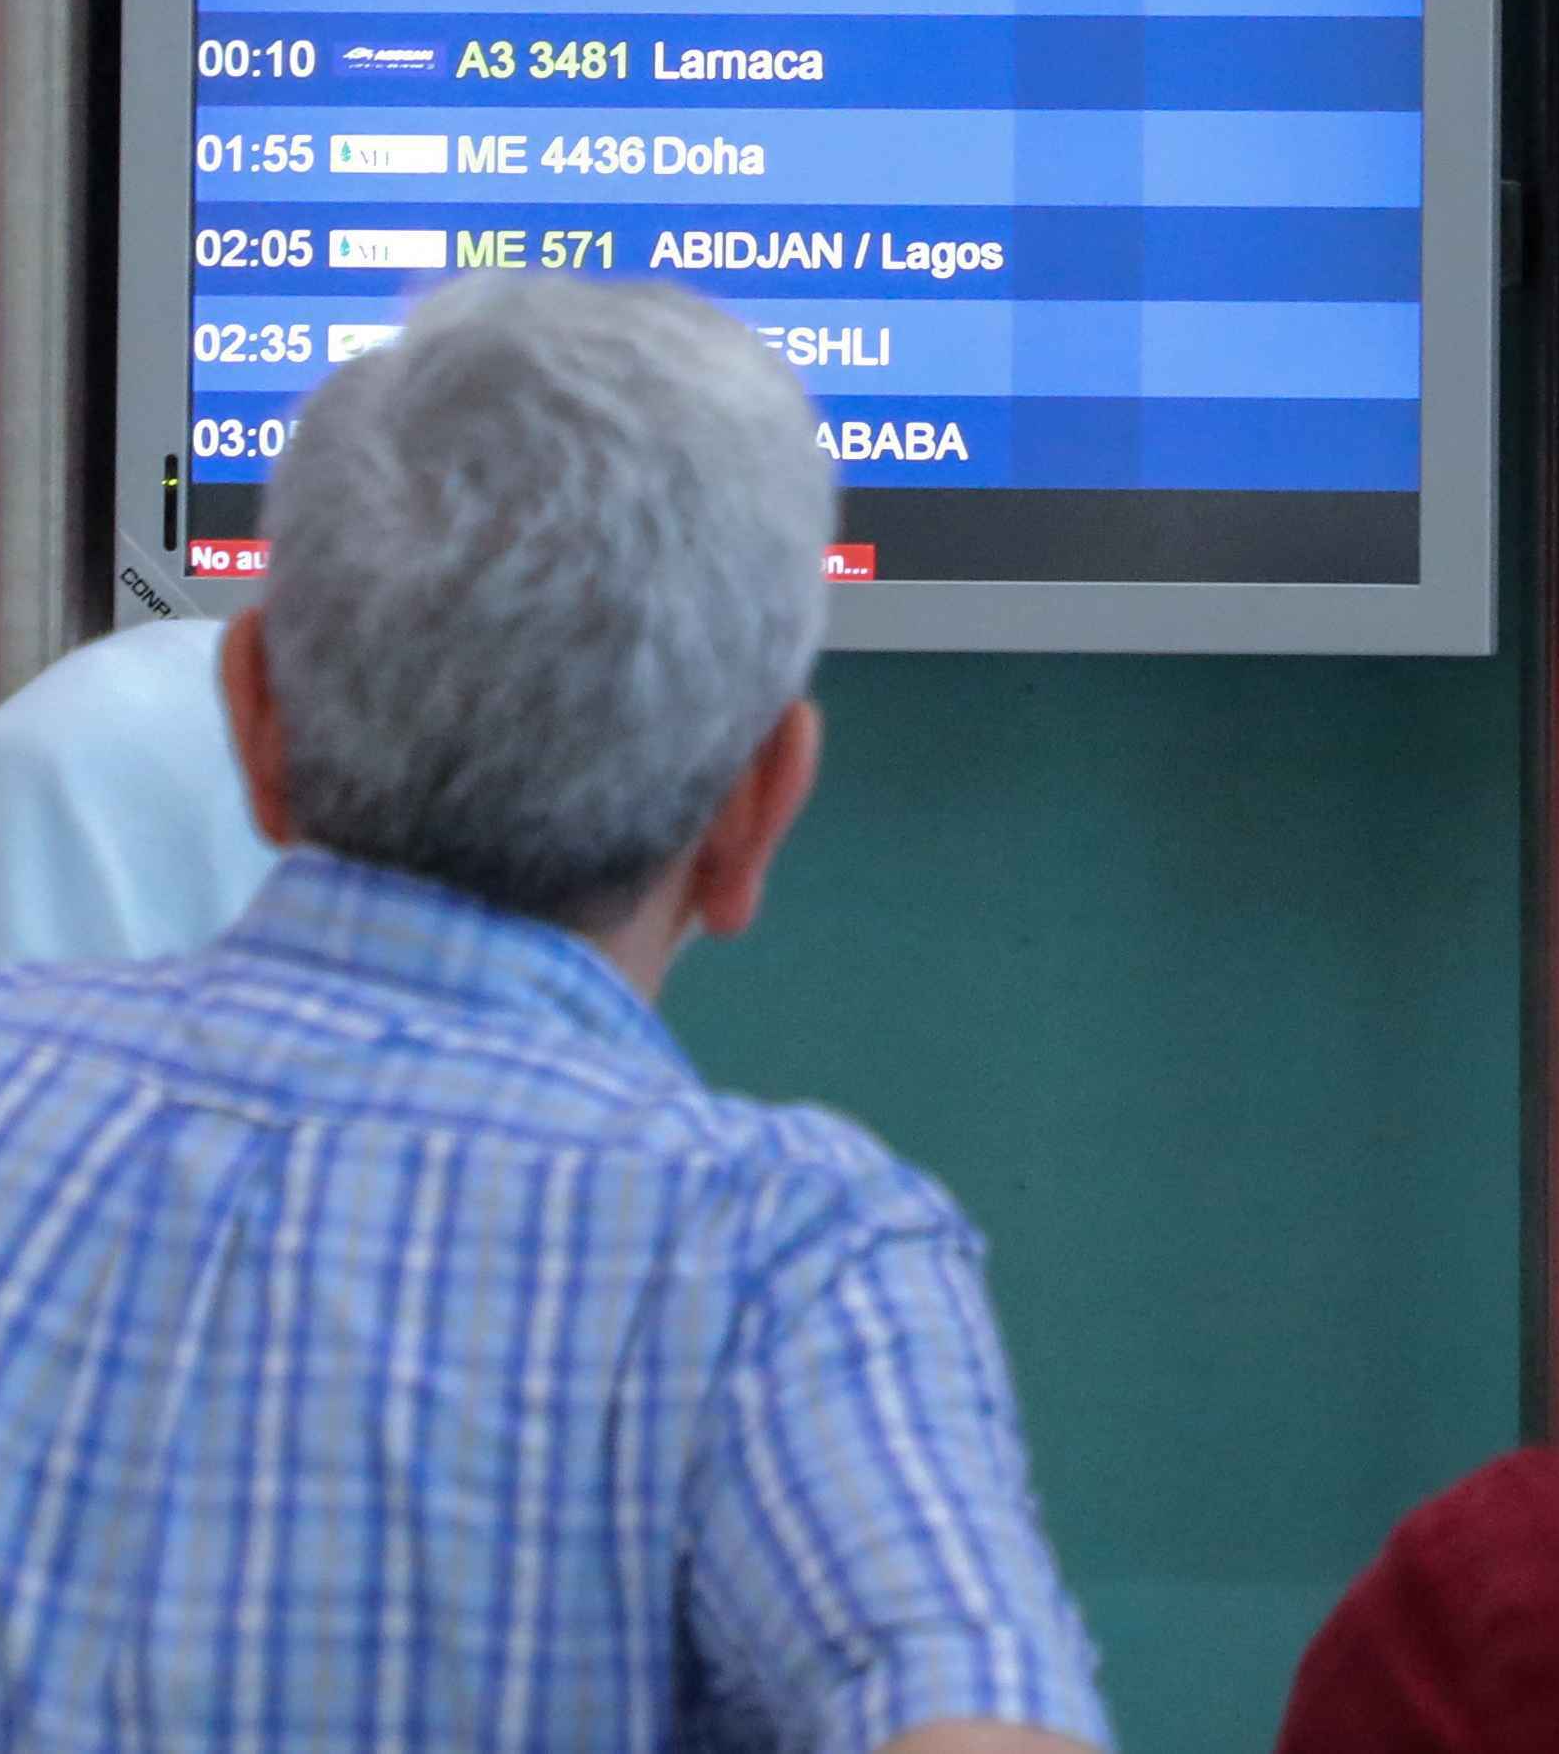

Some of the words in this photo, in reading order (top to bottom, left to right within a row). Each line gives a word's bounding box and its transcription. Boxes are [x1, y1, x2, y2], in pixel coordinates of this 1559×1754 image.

[198, 39, 316, 78] 00:10
[455, 40, 516, 79] A3
[529, 40, 627, 79] 3481
[195, 229, 314, 268] 02:05
[457, 230, 527, 269] ME
[541, 231, 612, 269] 571
[649, 231, 843, 270] ABIDJAN
[881, 232, 1004, 279] Lagos
[194, 323, 313, 363] 02:35
[193, 419, 298, 457] 03:0
[191, 545, 232, 571] No
[120, 566, 178, 620] CONR
